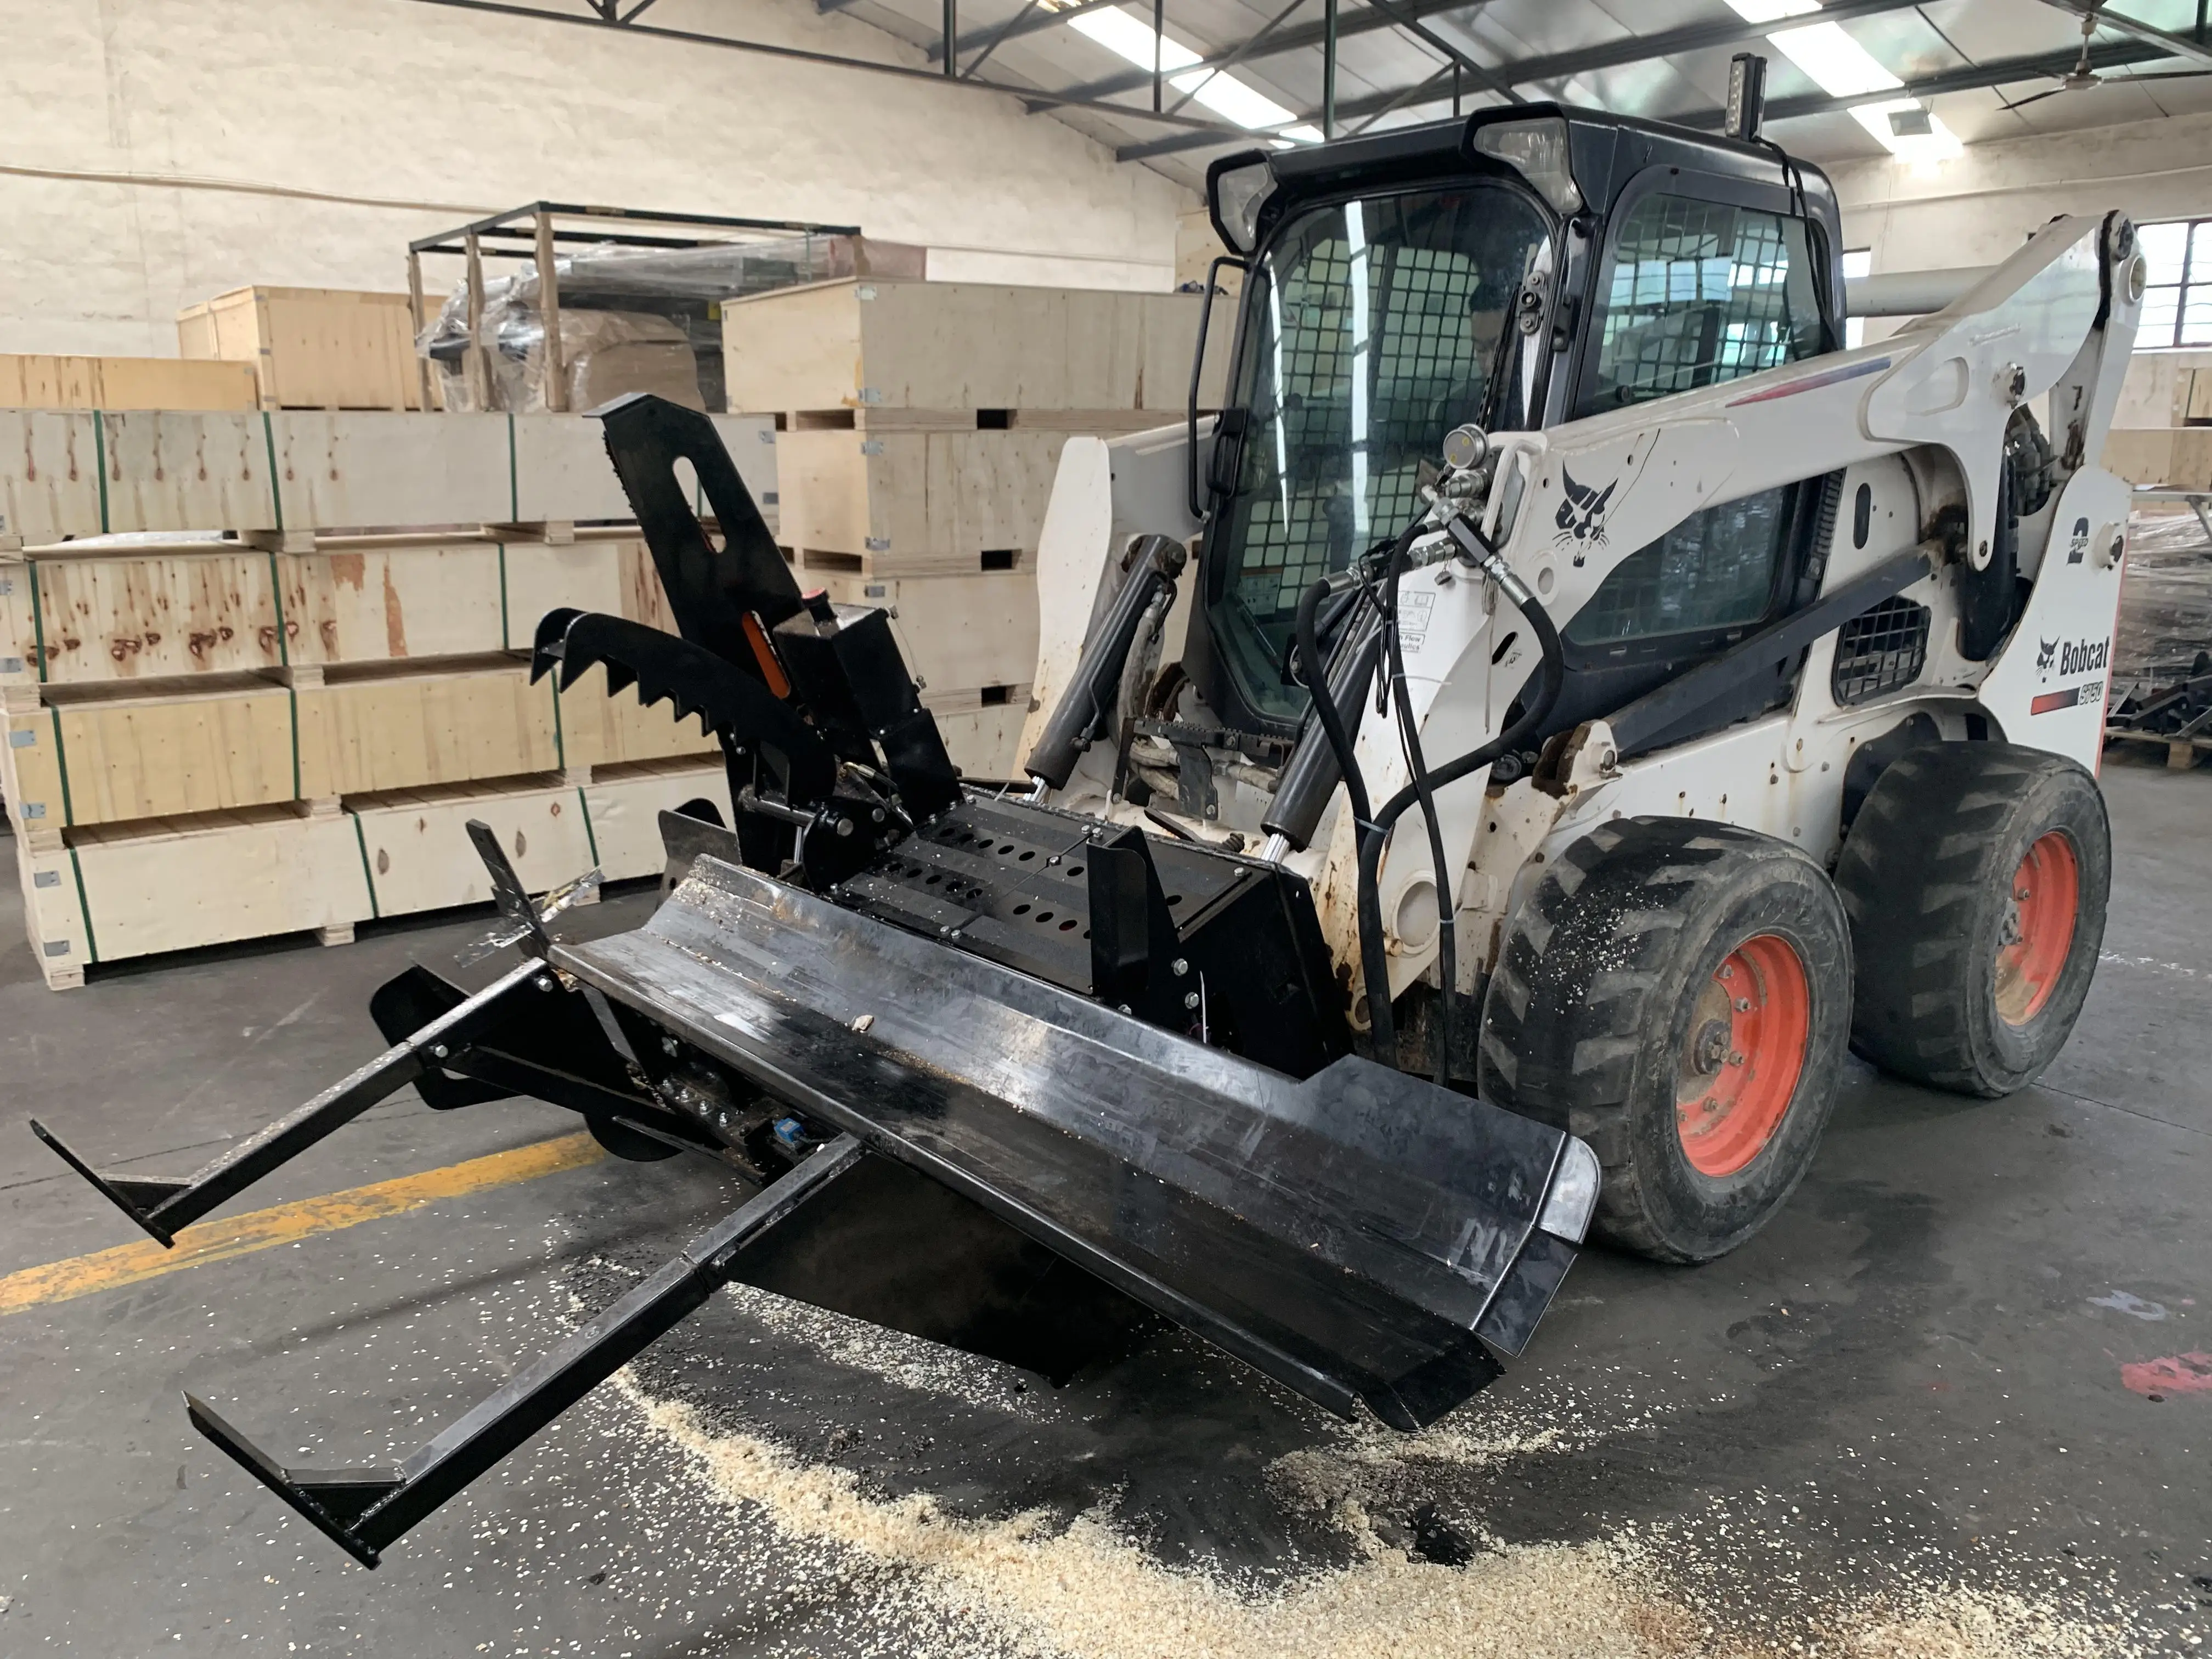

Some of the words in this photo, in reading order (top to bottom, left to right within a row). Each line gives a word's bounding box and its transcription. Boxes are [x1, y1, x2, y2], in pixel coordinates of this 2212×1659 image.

[1404, 634, 1421, 642] Flow
[2059, 635, 2110, 676] Bobcat
[2079, 681, 2104, 706] S750
